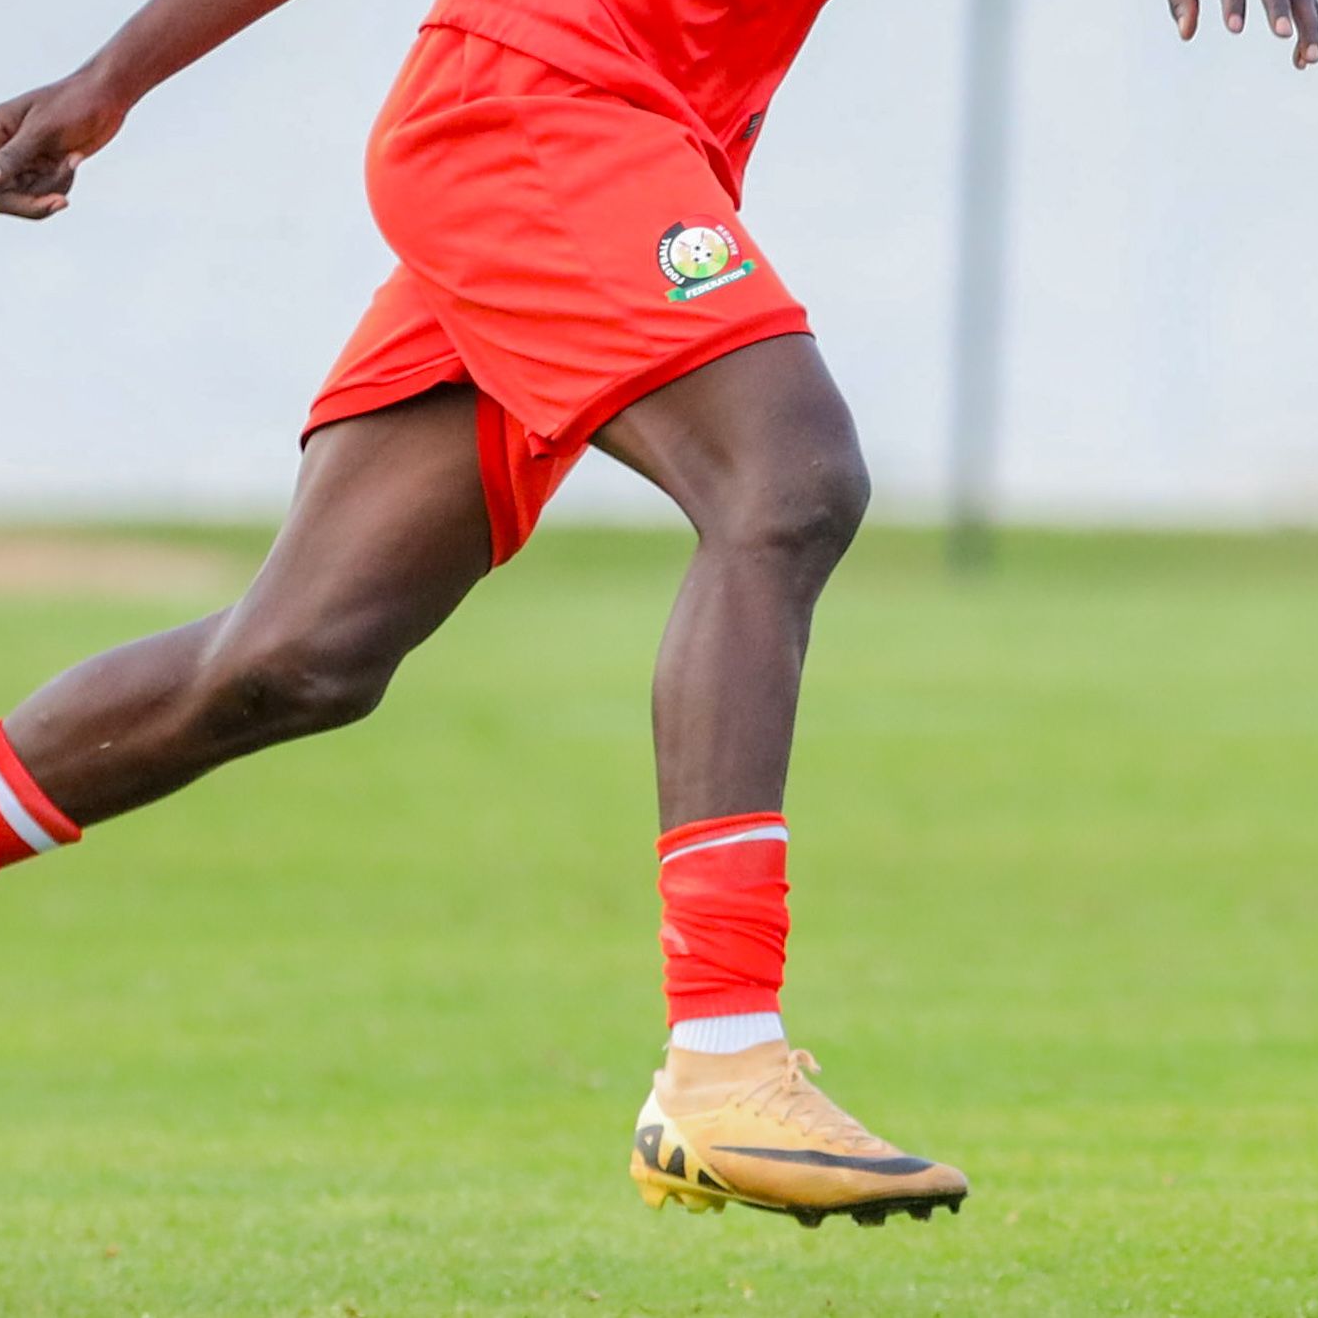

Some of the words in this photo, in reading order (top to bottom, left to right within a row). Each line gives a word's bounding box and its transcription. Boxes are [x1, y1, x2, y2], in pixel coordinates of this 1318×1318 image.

[715, 224, 739, 256] KENYA
[659, 238, 685, 285] FOOTBALL
[685, 268, 746, 298] FEDERATION
